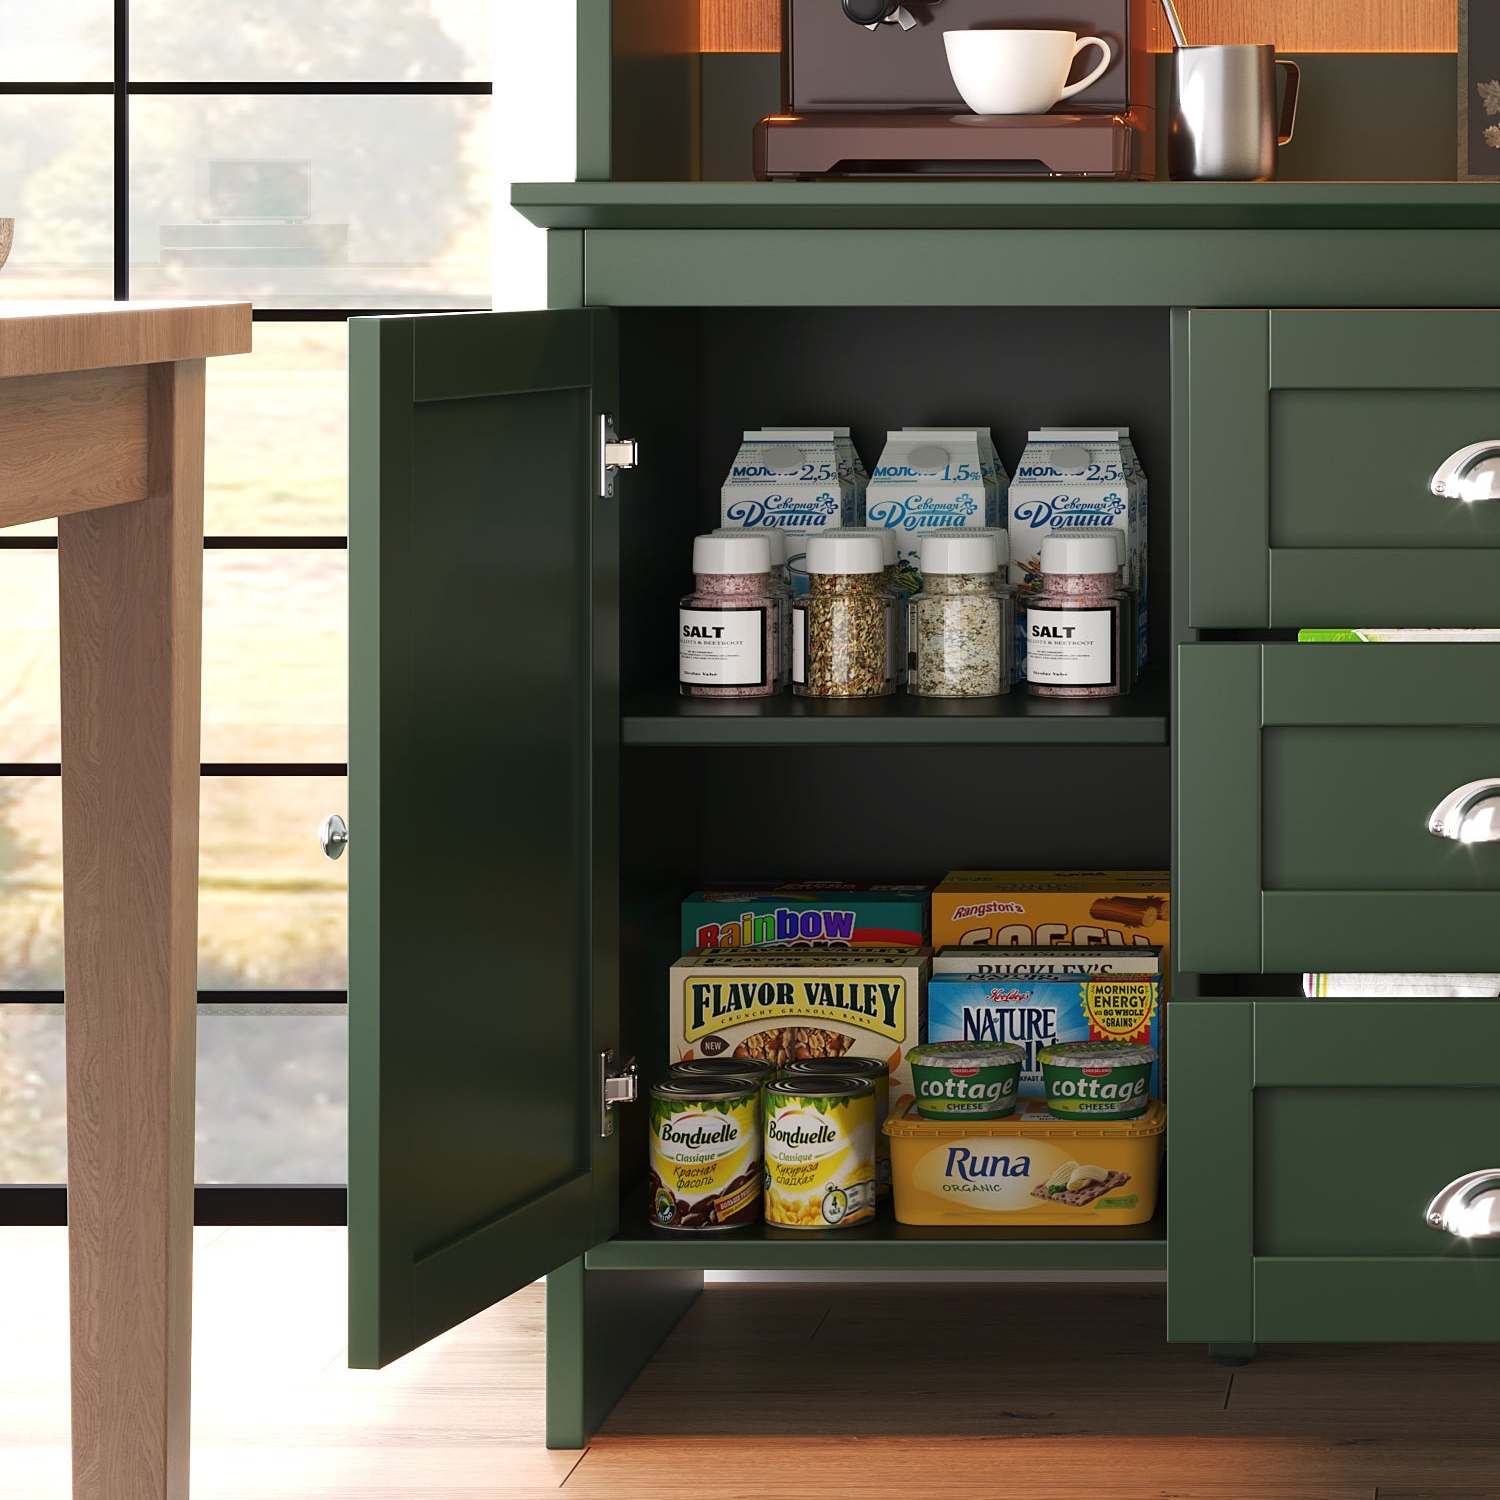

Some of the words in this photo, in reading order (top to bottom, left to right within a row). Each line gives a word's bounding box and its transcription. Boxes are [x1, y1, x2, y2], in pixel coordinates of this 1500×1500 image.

[941, 464, 981, 483] 1,5%
[764, 494, 820, 512] Северная
[905, 494, 959, 512] Северная
[1051, 494, 1106, 512] Северная
[727, 500, 827, 528] Долина
[868, 501, 966, 531] Долина
[1014, 500, 1114, 530] Долина
[683, 625, 725, 638] SALT
[1032, 625, 1076, 638] SALT
[952, 901, 1026, 921] Rangston's
[697, 908, 856, 948] Rainbow
[1095, 985, 1145, 994] MORNING
[692, 982, 795, 1030] FLAVOR
[803, 982, 900, 1028] VALLEY
[1094, 996, 1147, 1007] ENERGY
[721, 1009, 774, 1024] CRUNCHY
[781, 1008, 834, 1016] GRANOLA
[843, 1013, 871, 1024] BARS
[963, 1007, 1056, 1042] NATURE
[1106, 1018, 1132, 1027] GRAINS
[705, 1042, 721, 1051] NEW
[920, 1077, 1014, 1101] cottage
[1052, 1077, 1144, 1101] cottage
[947, 1102, 984, 1111] CHEESE
[1079, 1102, 1116, 1111] CHEESE
[662, 1124, 737, 1149] Bonduelle
[769, 1121, 836, 1148] Bonduelle
[675, 1153, 715, 1163] Classique
[778, 1152, 813, 1163] Classique
[945, 1147, 1030, 1182] Runa
[673, 1164, 717, 1179] Красная
[942, 1184, 1002, 1193] ORGANIC
[832, 1197, 838, 1208] 4
